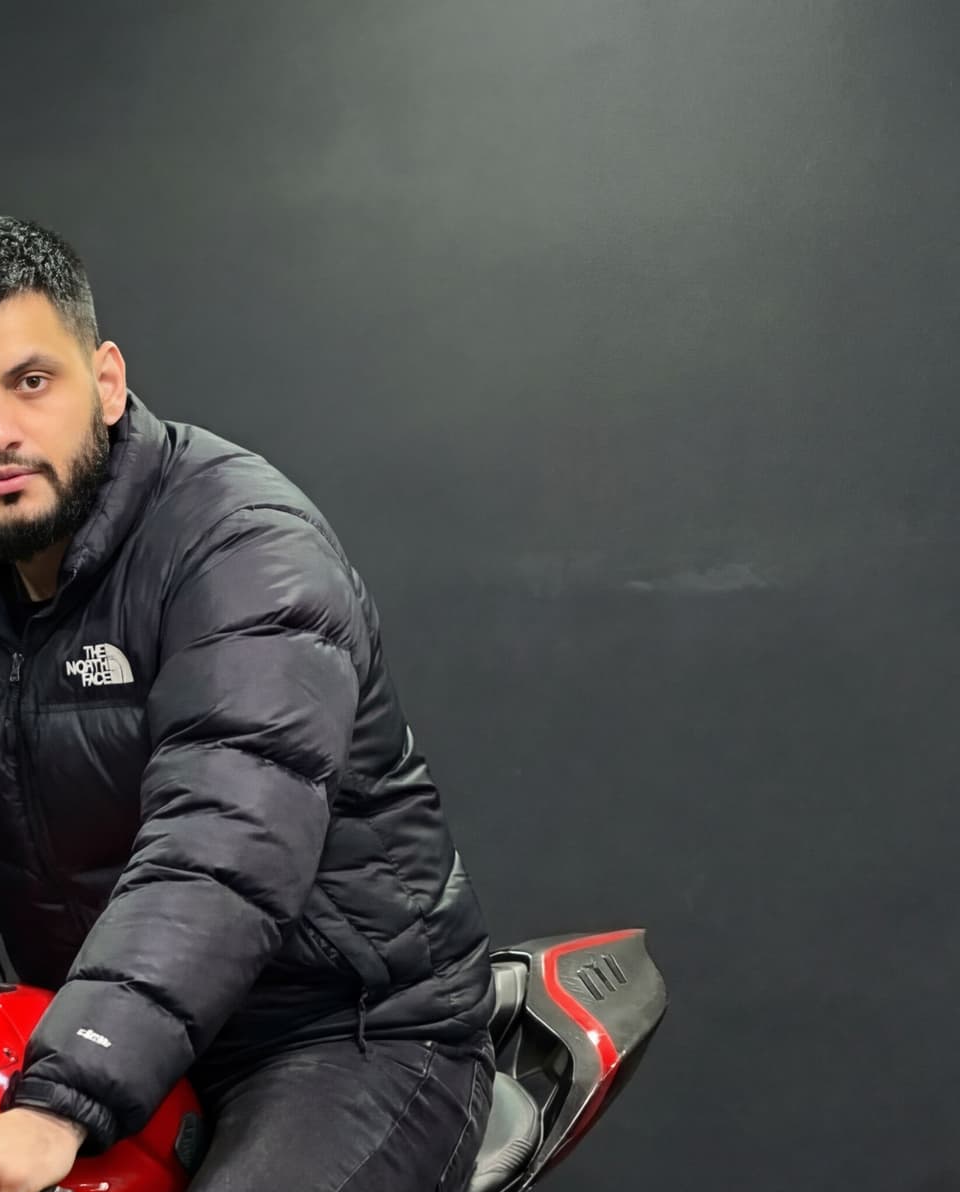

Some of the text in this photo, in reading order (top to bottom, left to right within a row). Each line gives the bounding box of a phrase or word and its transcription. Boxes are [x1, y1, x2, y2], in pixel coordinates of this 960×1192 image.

[83, 644, 106, 659] THE
[65, 658, 109, 676] NORTH
[82, 671, 112, 687] FACE
